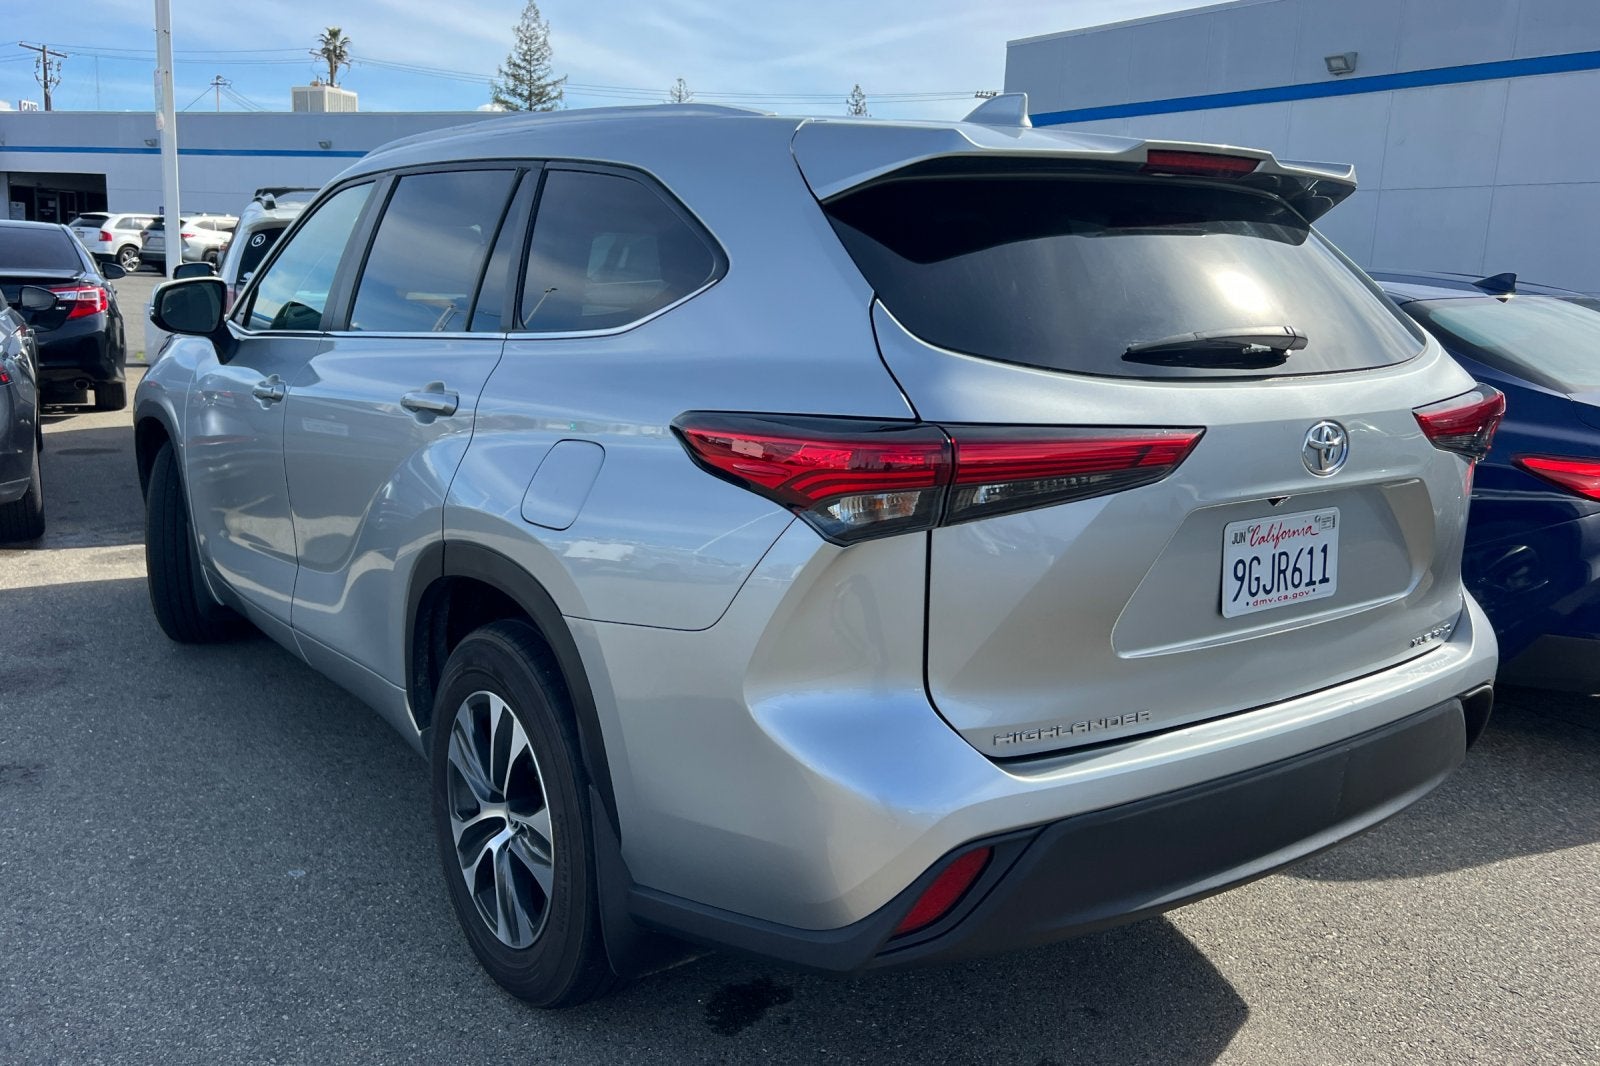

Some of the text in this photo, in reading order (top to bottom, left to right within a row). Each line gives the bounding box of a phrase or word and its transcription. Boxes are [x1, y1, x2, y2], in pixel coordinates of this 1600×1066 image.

[1232, 532, 1246, 545] JUN
[1250, 522, 1319, 549] California
[1232, 544, 1330, 602] 9GJR611
[1252, 590, 1310, 607] dmv.ca.gov
[993, 710, 1151, 746] HIGHLANDER
